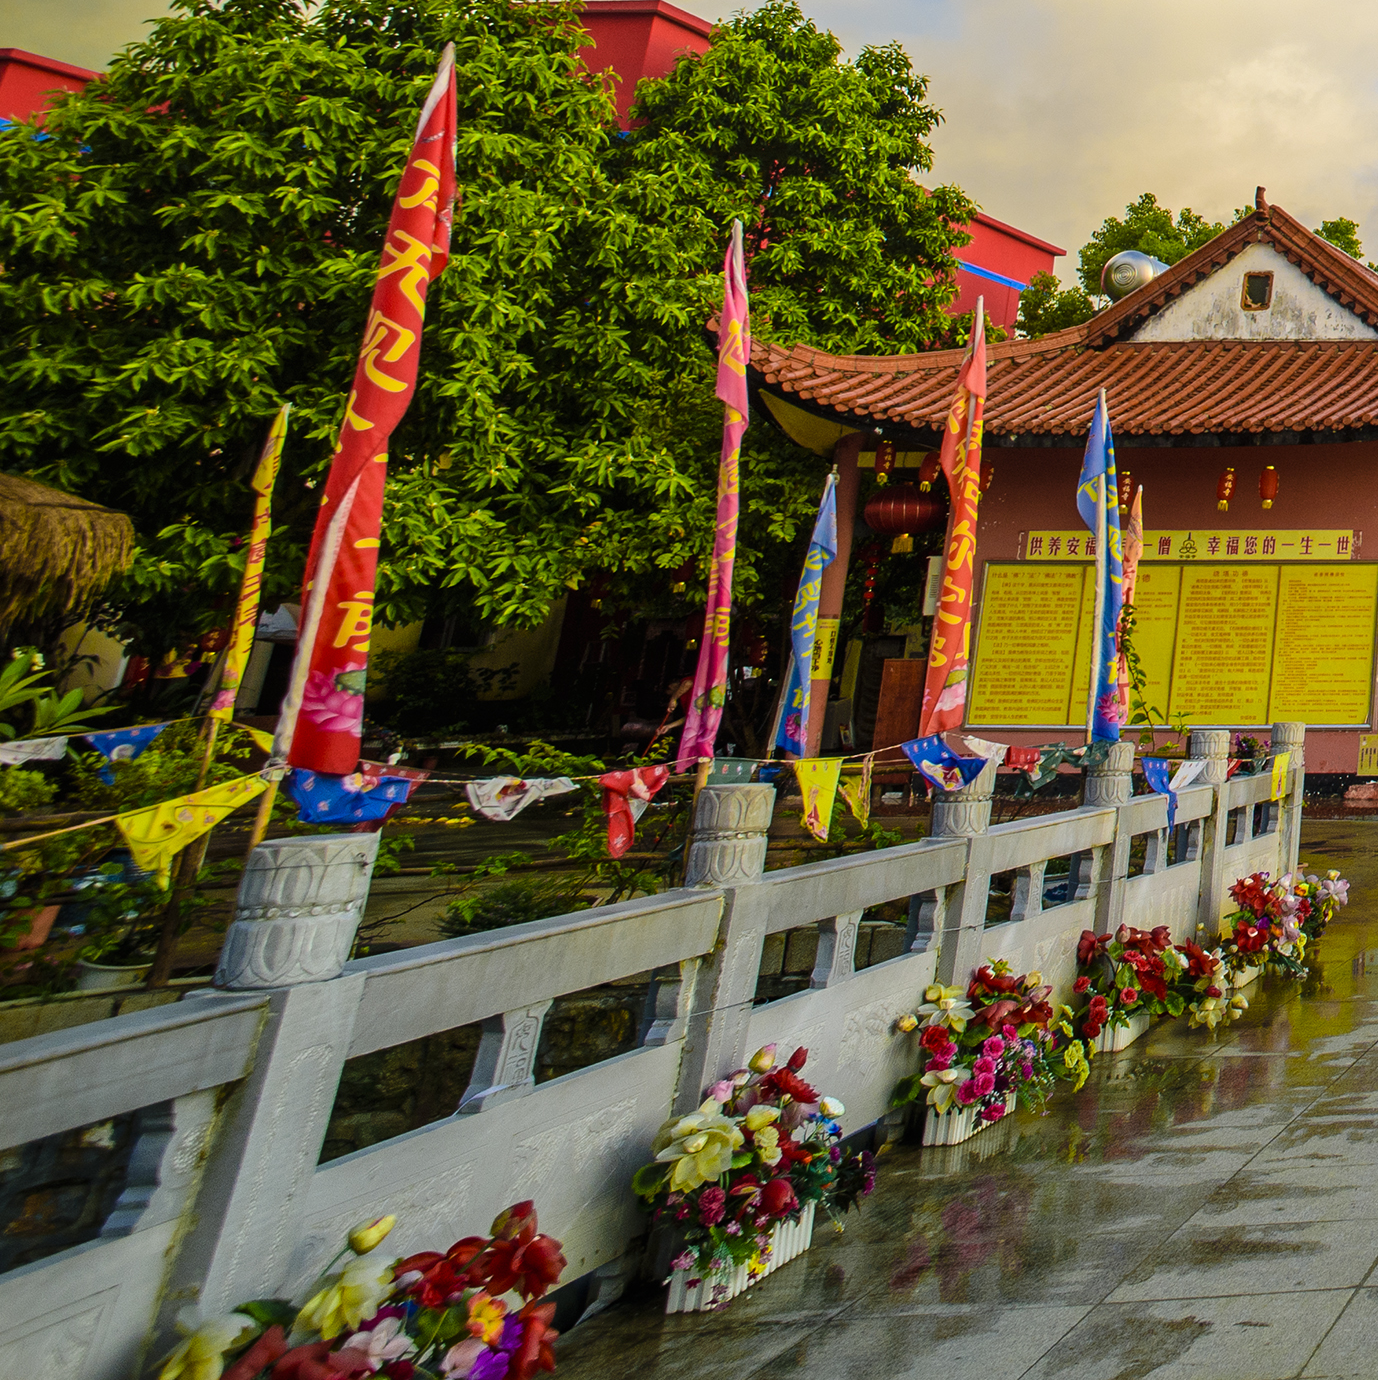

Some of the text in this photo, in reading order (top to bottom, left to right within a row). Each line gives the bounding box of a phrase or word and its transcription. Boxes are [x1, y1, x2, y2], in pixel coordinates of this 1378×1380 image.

[1122, 477, 1132, 501] 安福寺
[1029, 535, 1172, 557] 供养安福一僧
[1206, 535, 1352, 556] 幸福您的一生一世
